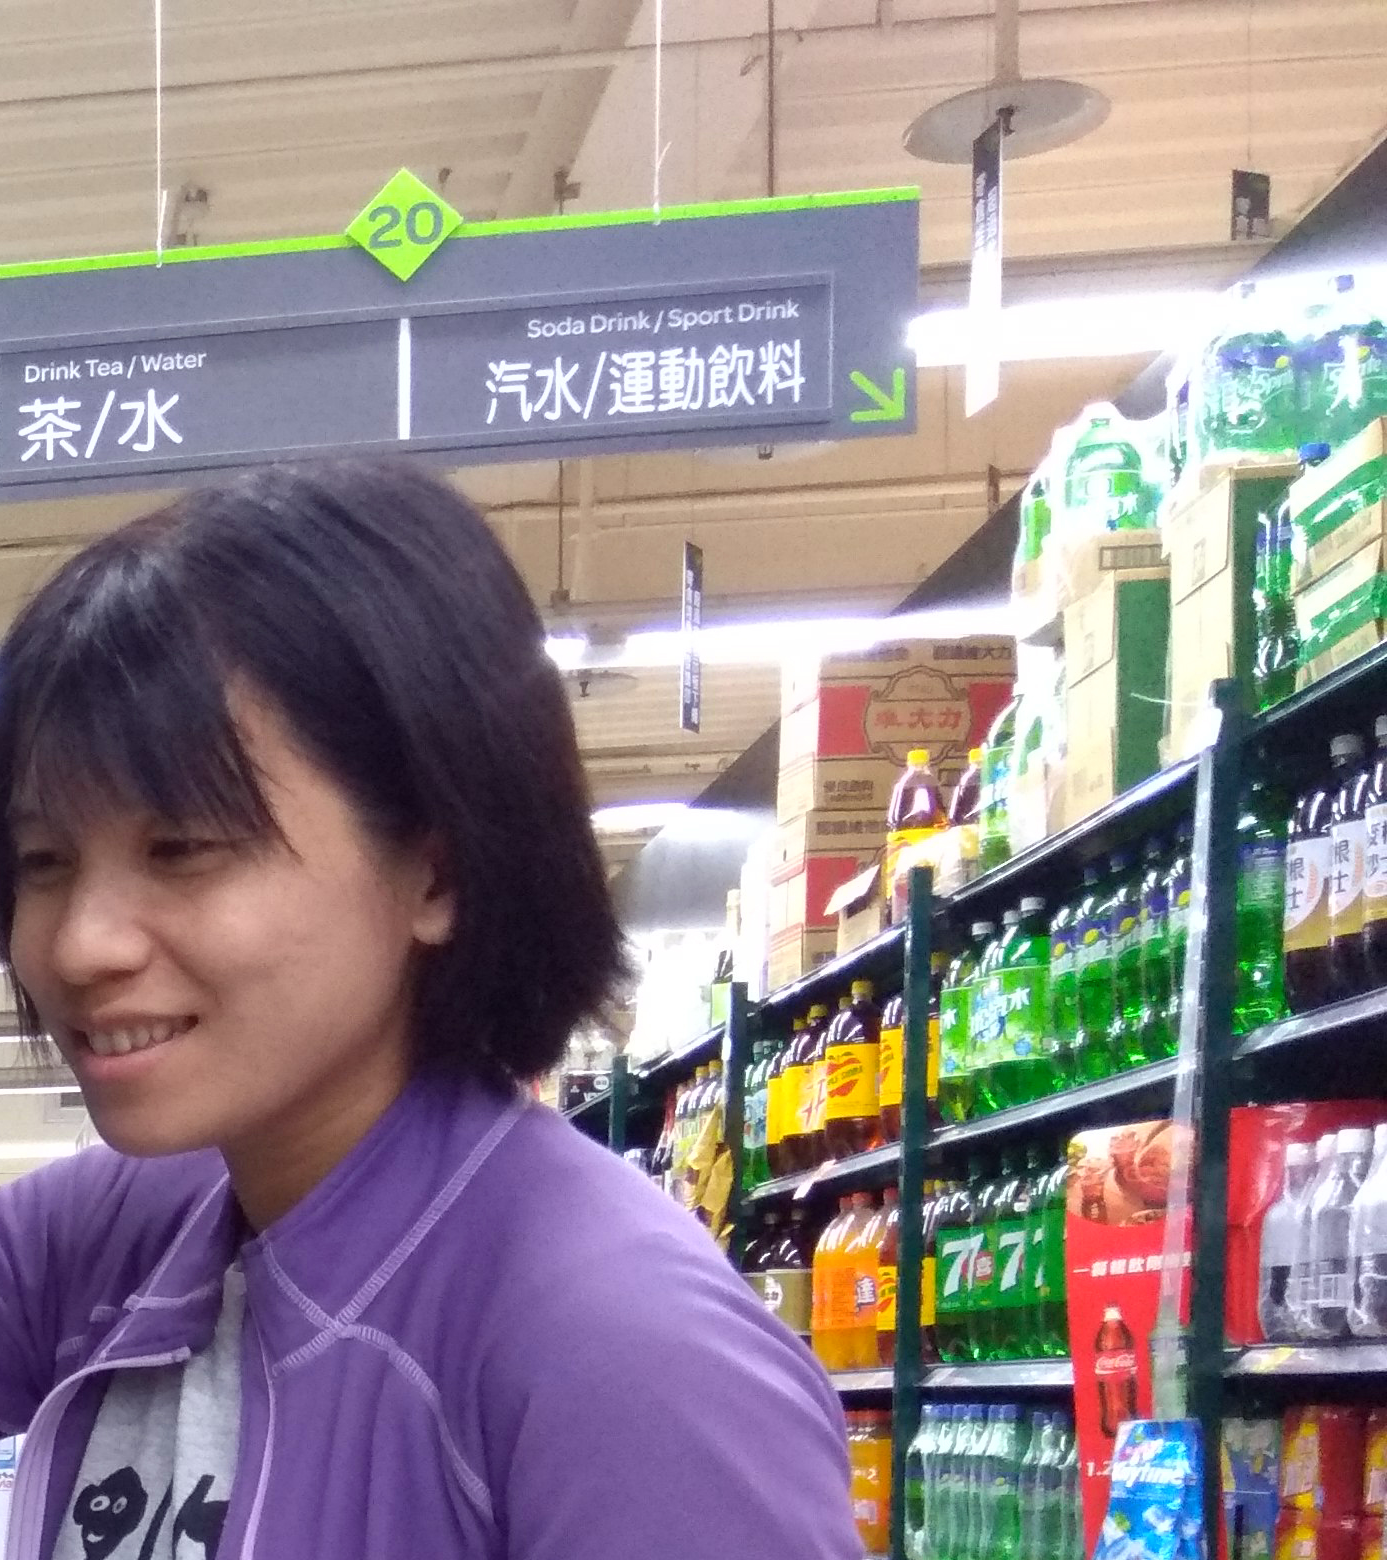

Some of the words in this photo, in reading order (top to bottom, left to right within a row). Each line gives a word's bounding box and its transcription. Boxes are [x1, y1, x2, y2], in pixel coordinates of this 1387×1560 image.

[368, 202, 444, 249] 20
[527, 319, 586, 339] Soda
[590, 311, 651, 334] Drink
[667, 304, 733, 331] Sport
[737, 298, 801, 323] Drink
[24, 360, 82, 384] Drink
[85, 358, 124, 378] Tea
[140, 350, 208, 373] Water
[485, 338, 807, 424] 汽水/運動飲料
[18, 387, 184, 463] 茶/水
[1086, 1460, 1112, 1477] 1.2
